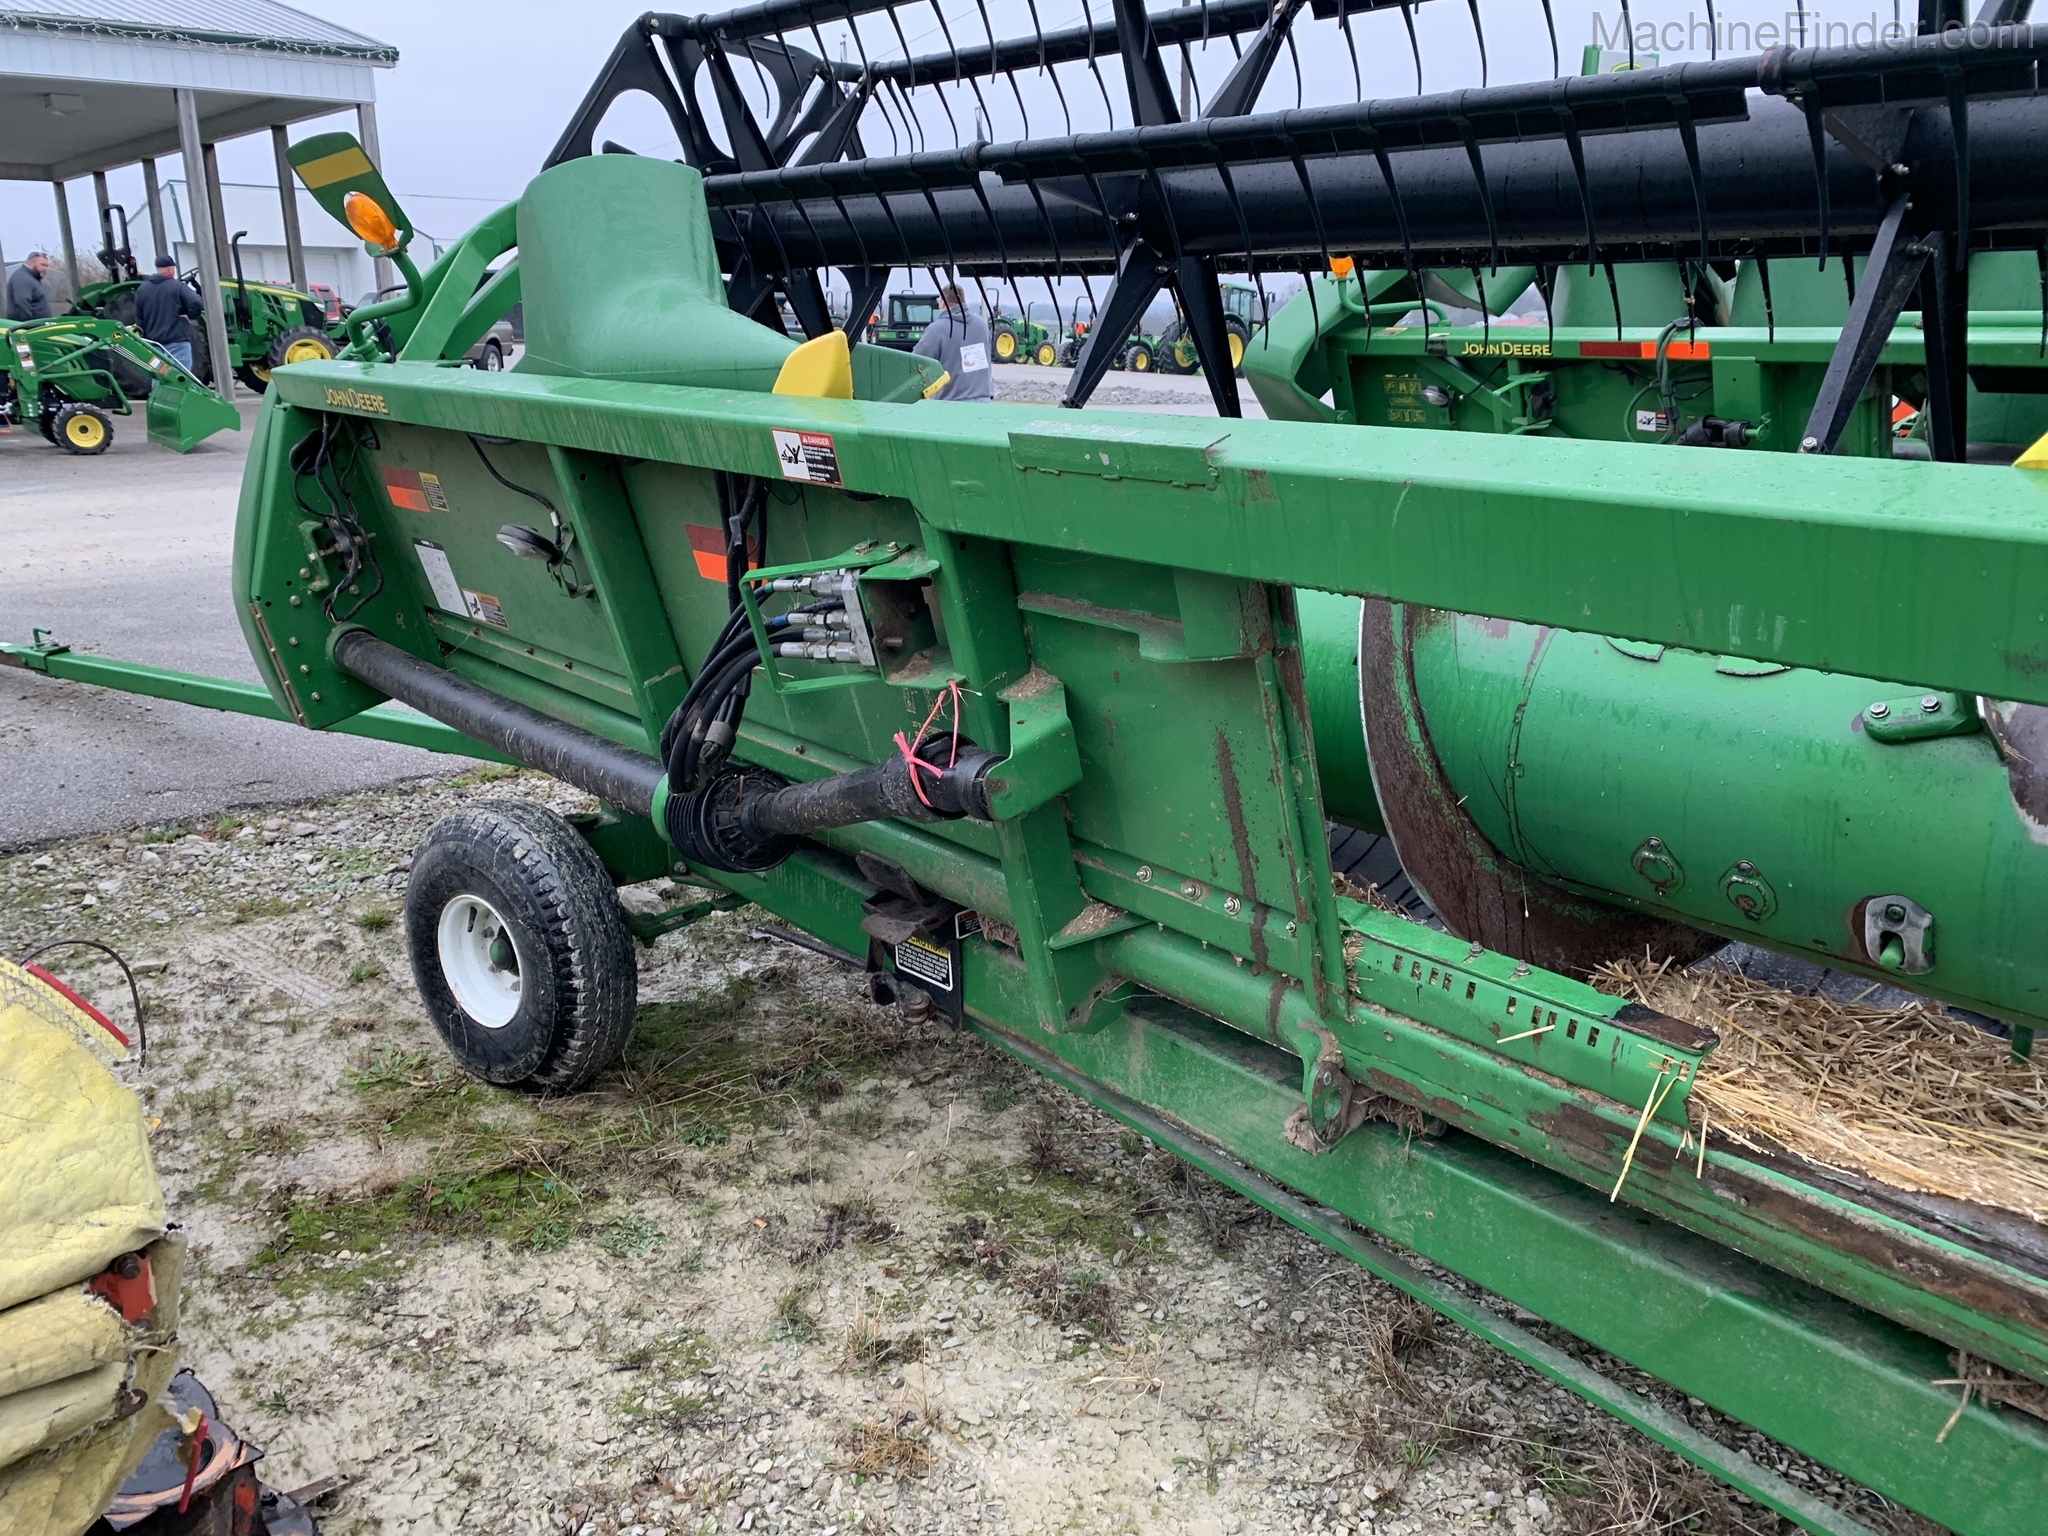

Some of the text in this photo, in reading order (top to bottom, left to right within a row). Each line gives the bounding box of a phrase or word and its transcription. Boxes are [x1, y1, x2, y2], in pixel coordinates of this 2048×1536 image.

[1461, 341, 1500, 356] JOHN
[1501, 342, 1552, 356] DEERE
[323, 384, 388, 413] JOHN DEERE
[807, 437, 830, 446] DANGER
